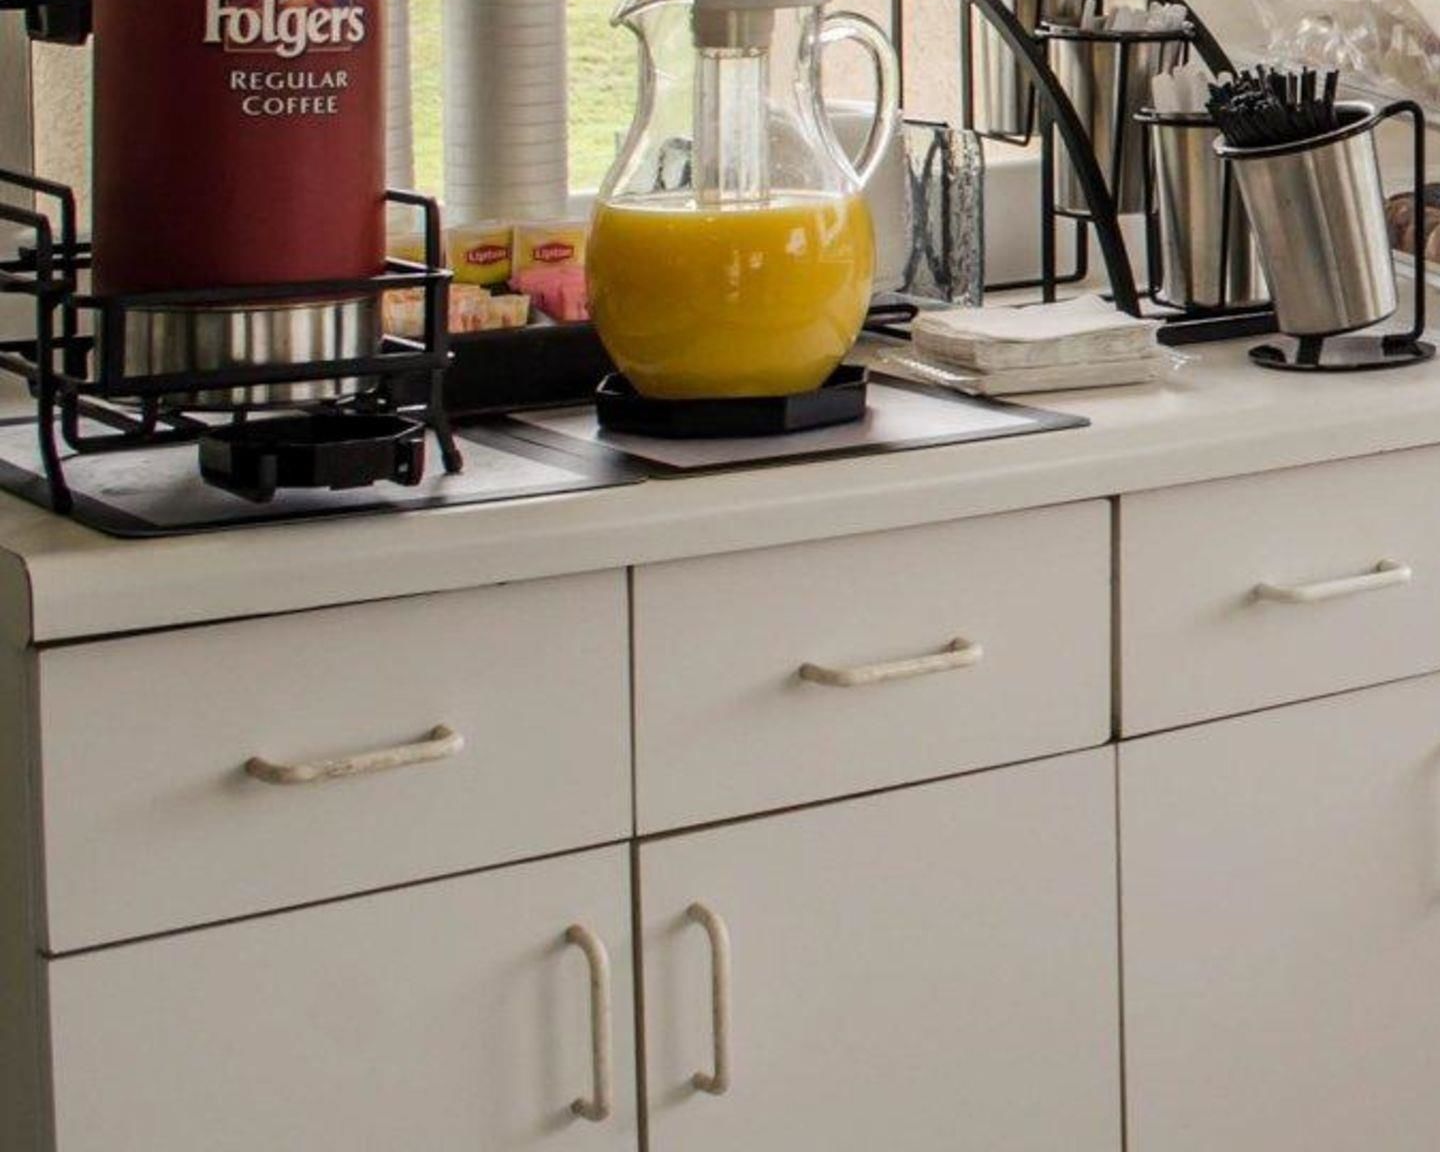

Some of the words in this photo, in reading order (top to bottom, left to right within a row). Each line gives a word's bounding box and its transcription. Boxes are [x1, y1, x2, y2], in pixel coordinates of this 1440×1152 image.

[229, 70, 349, 90] REGULAR
[241, 95, 339, 116] COFFEE
[468, 248, 507, 263] Lipton
[535, 246, 573, 260] Lipton
